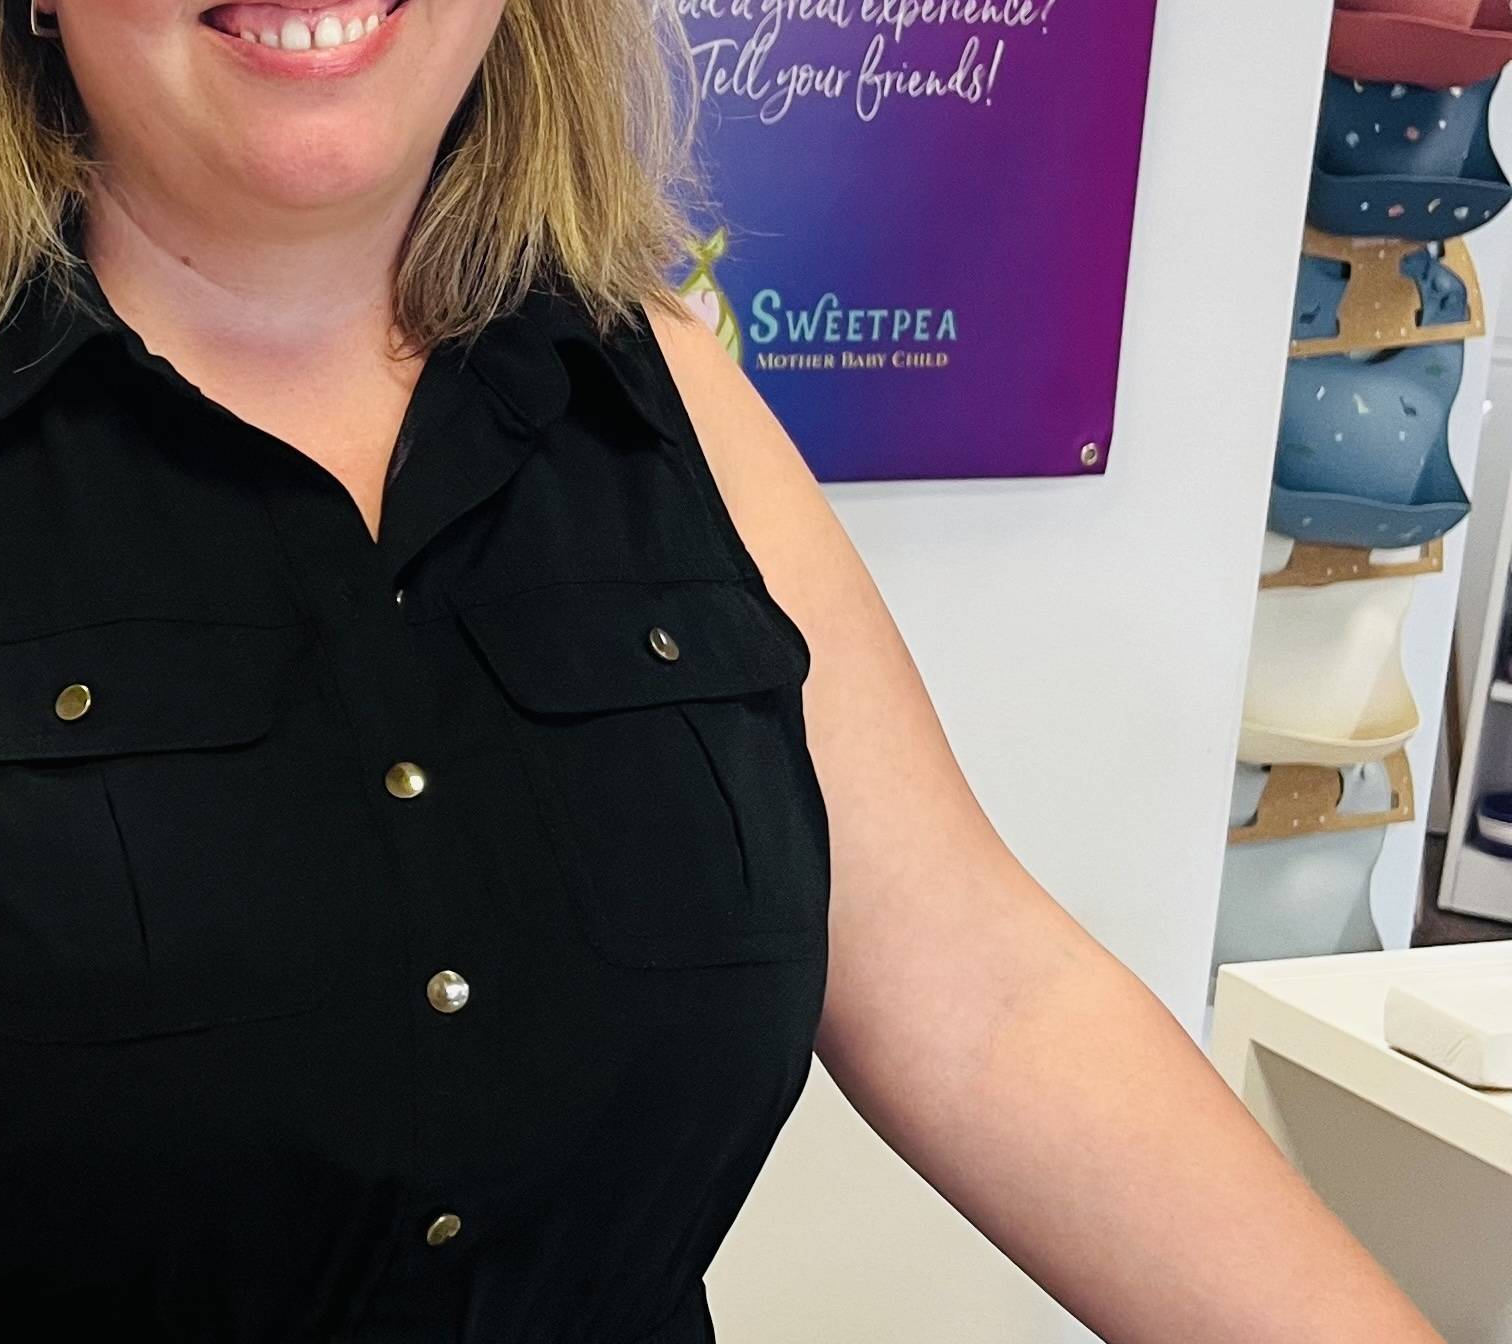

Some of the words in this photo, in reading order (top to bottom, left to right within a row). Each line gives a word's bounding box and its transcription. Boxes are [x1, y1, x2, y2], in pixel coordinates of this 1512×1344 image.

[689, 32, 771, 101] Tell
[759, 62, 851, 125] your
[856, 33, 1005, 123] friends!
[748, 288, 958, 345] SWEETPEA
[755, 352, 836, 370] MOTHER
[840, 350, 887, 369] BABY
[890, 349, 950, 369] CHILD
